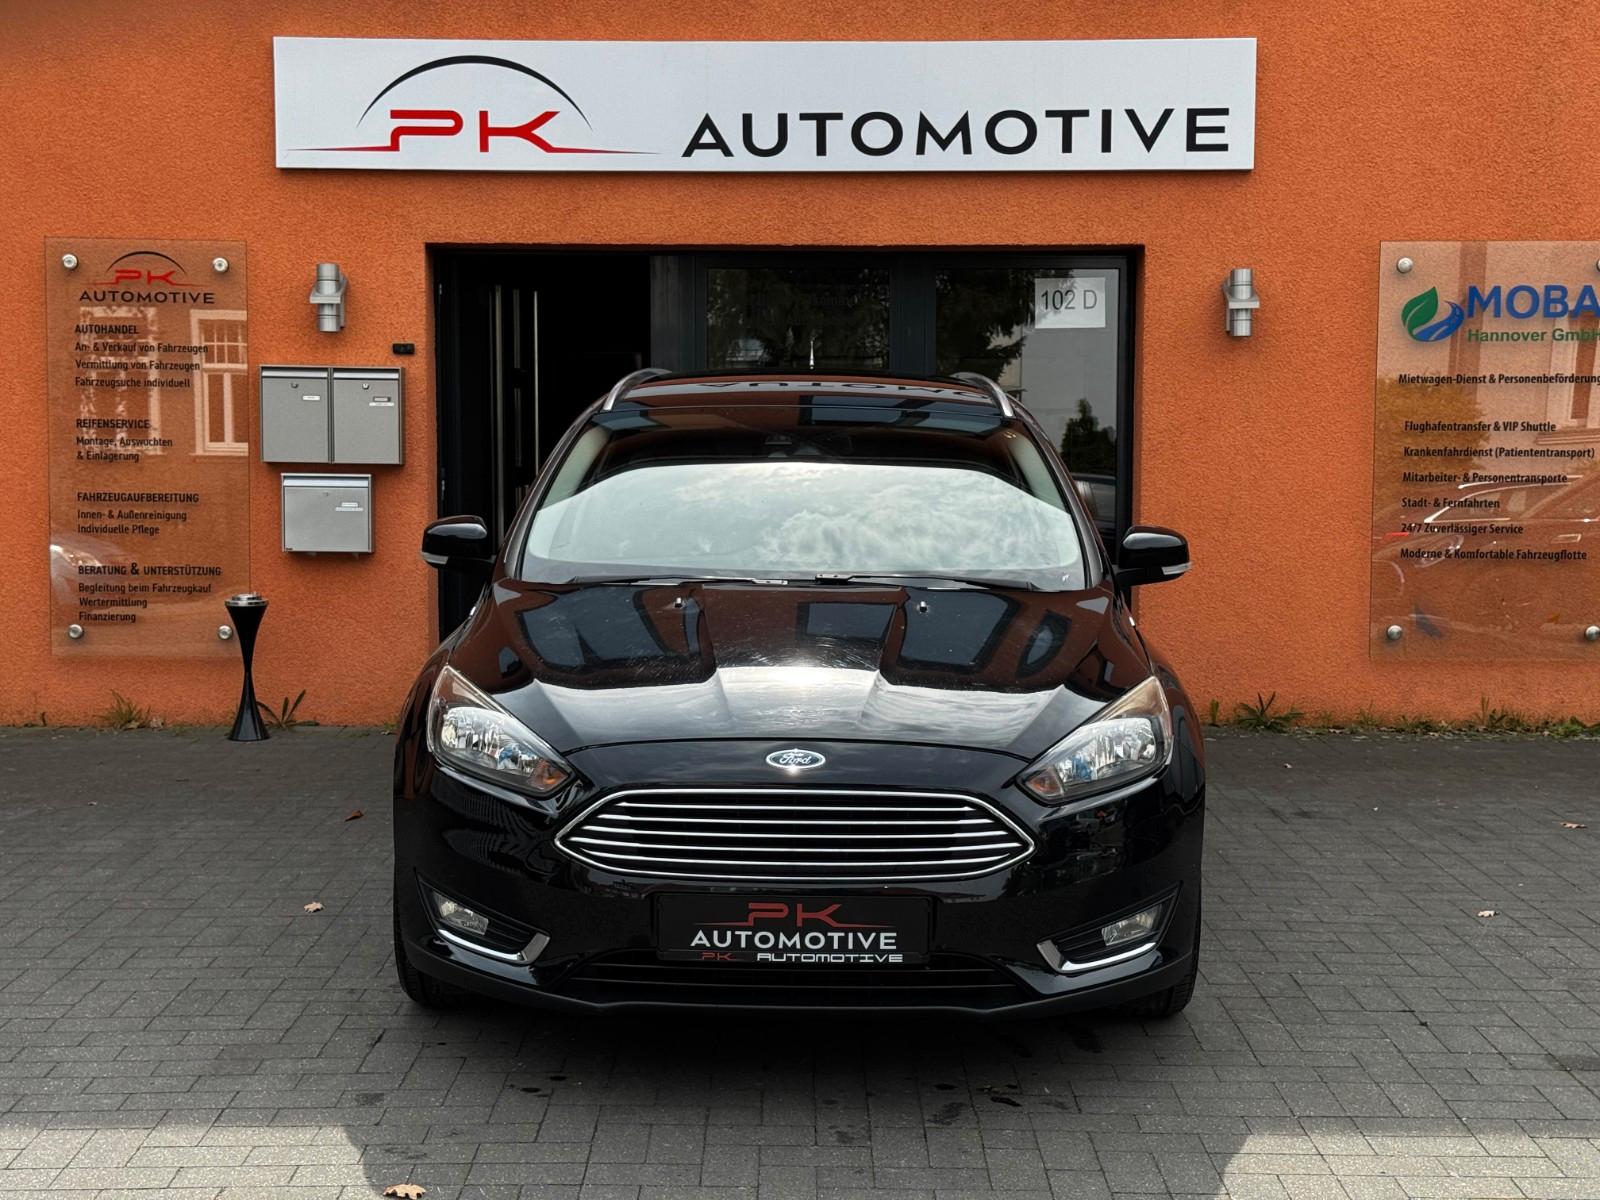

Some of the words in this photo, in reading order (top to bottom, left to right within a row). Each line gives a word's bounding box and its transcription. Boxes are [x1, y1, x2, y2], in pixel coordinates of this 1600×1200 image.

[389, 109, 560, 152] PK
[681, 108, 1231, 157] AUTOMOTIVE
[114, 270, 177, 286] PK
[80, 291, 215, 304] AUTOMOTIVE
[1041, 290, 1075, 310] 102
[1084, 290, 1097, 309] D
[75, 325, 139, 335] AUTOHANDEL
[1468, 328, 1546, 342] Hannover
[75, 344, 90, 352] An-
[93, 344, 99, 352] &
[102, 343, 137, 352] Verkauf
[157, 344, 208, 354] Fahrzeugen
[75, 360, 128, 371] Vermittlung
[130, 362, 147, 370] von
[149, 361, 200, 371] Fahrzeugen
[75, 377, 141, 388] Fahrzeugsuche
[144, 378, 191, 387] individuell
[1398, 374, 1486, 386] Mietwagen-Dienst
[1489, 374, 1496, 383] &
[76, 419, 150, 428] REIFENSERVICE
[1404, 421, 1491, 433] Flughafentransfer
[1493, 422, 1500, 431] &
[1503, 422, 1518, 431] VIP
[1520, 422, 1556, 432] Shuttle
[76, 437, 117, 447] Montage,
[77, 452, 83, 460] &
[86, 451, 139, 462] Einlagerung
[1404, 447, 1493, 457] Krankenfahrdienst
[1495, 447, 1595, 459] (Patiententransport)
[1402, 472, 1460, 483] Mitarbeiter-
[1463, 473, 1470, 482] &
[1472, 473, 1568, 485] Personentransporte
[77, 493, 199, 502] FAHRZEUGAUFBEREITUNG
[1401, 498, 1431, 508] Stadt-
[1433, 499, 1440, 508] &
[1442, 498, 1500, 508] Fernfahrten
[77, 511, 105, 520] Innen-
[108, 511, 114, 519] &
[117, 511, 187, 521] Außenreinigung
[78, 525, 129, 534] Individuelle
[132, 525, 160, 536] Pflege
[1401, 524, 1422, 533] 24/7
[1424, 523, 1487, 535] Zuverlässiger
[1489, 524, 1523, 534] Service
[1401, 549, 1442, 559] Moderne
[1444, 550, 1452, 559] &
[1454, 550, 1514, 559] Komfortable
[1516, 550, 1587, 562] Fahrzeugflotte
[78, 566, 126, 575] BERATUNG
[131, 563, 139, 575] &
[144, 564, 221, 575] UNTERSTÜTZUNG
[79, 584, 125, 594] Begleitung
[128, 584, 149, 593] beim
[152, 584, 211, 595] Fahrzeugkauf
[79, 598, 147, 609] Wertermittlung
[79, 612, 136, 623] Finanzierung
[780, 753, 811, 764] Ford
[748, 903, 842, 927] PK
[690, 930, 897, 950] AUTOMOTIVE
[757, 953, 903, 962] AUTOMOTIVE
